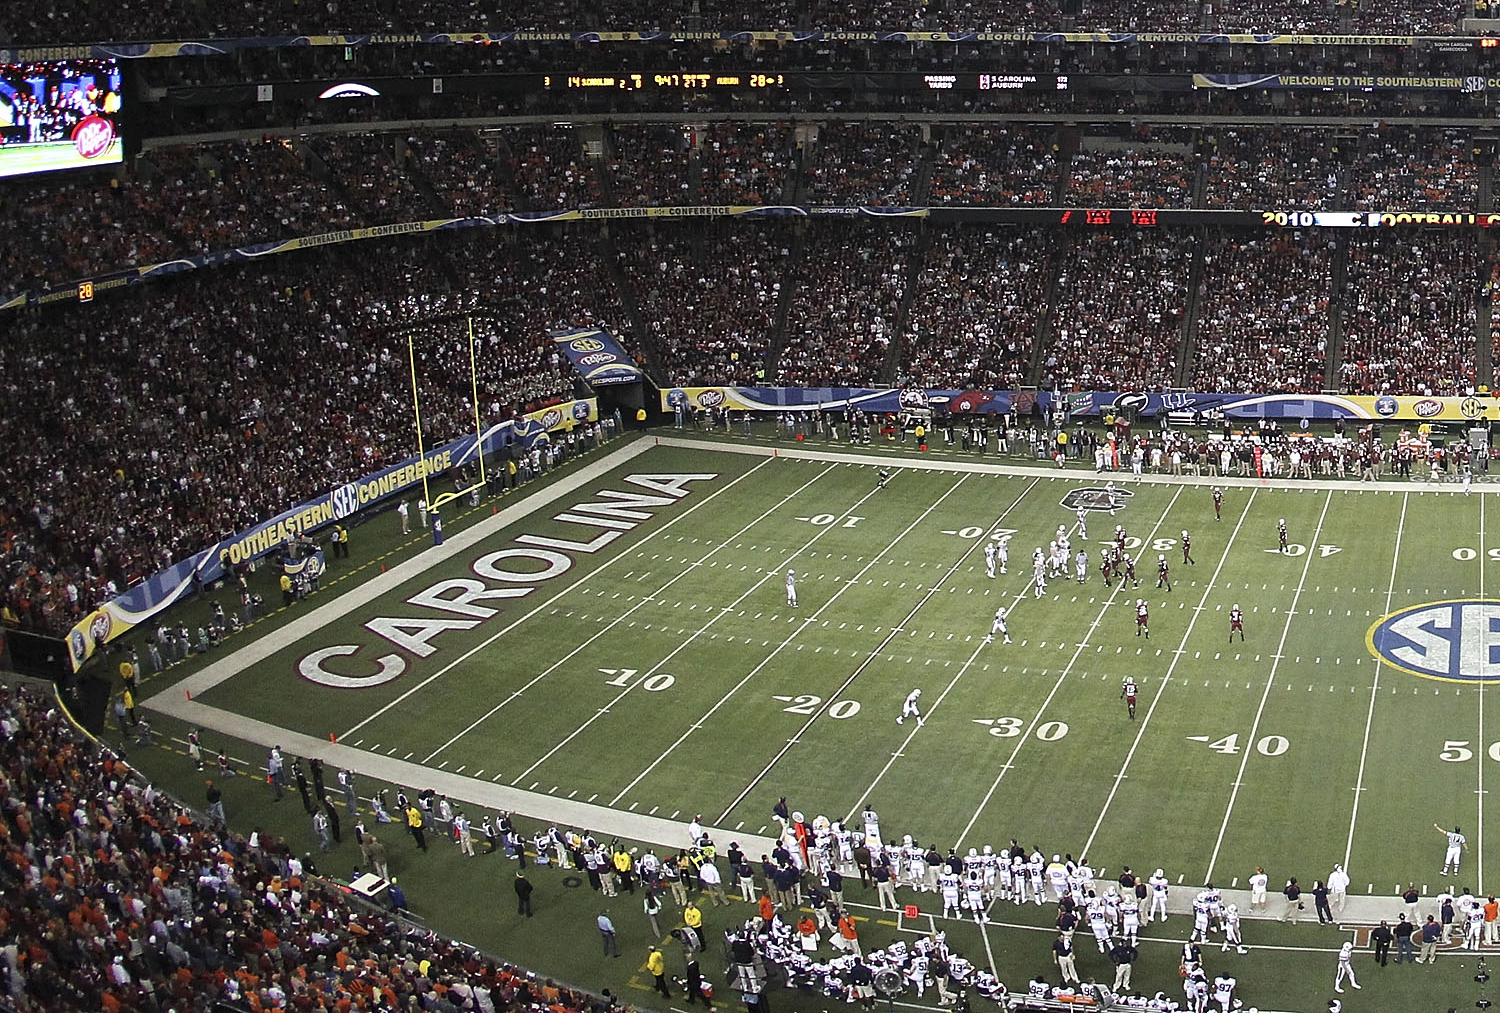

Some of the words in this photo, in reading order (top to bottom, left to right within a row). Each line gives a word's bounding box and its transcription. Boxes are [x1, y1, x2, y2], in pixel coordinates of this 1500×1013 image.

[369, 34, 422, 43] ALABAMA
[514, 33, 571, 41] ARKANSAS
[669, 32, 721, 40] AUBURN
[823, 32, 877, 40] FLORIDA
[977, 33, 1035, 41] GEORGIA
[1136, 33, 1201, 42] KENTUCKY
[1312, 36, 1410, 45] SOUTHEASTERN
[18, 46, 92, 63] CONFERENCE
[567, 76, 580, 88] 14
[654, 75, 679, 87] 9:47
[750, 75, 766, 88] 28
[924, 75, 956, 83] PASSING
[1278, 75, 1334, 86] WELCOME
[1336, 76, 1350, 86] TO
[1352, 76, 1375, 87] THE
[1376, 76, 1463, 88] SOUTHEASTERN
[1465, 76, 1486, 92] SEC
[580, 208, 648, 218] SOUTHEASTERN
[669, 206, 731, 216] CONFERENCE
[810, 207, 859, 215] SECSPORTS.COM
[1262, 212, 1313, 227] 2010
[298, 232, 354, 247] SOUTHEASTERN
[371, 222, 425, 236] CONFERENCE
[38, 289, 78, 304] SOUTHEASTERN
[93, 277, 128, 291] CONFERENCE
[79, 284, 92, 299] 28
[573, 339, 602, 352] SEC
[591, 374, 636, 385] SECSPORTS.COM
[1417, 403, 1438, 416] Pepper
[1461, 399, 1480, 417] SEC
[358, 450, 452, 503] CONFERENCE
[333, 483, 358, 520] SEC
[811, 513, 866, 528] 10
[220, 500, 333, 570] SOUTHEASTERN
[953, 525, 1018, 541] 20
[1122, 536, 1178, 551] 30
[1283, 544, 1342, 558] 40
[298, 472, 719, 689] CAROLINA
[605, 668, 677, 692] 10
[783, 694, 861, 720] 20
[989, 716, 1070, 742] 30
[1208, 733, 1290, 756] 40
[1219, 983, 1231, 992] 97
